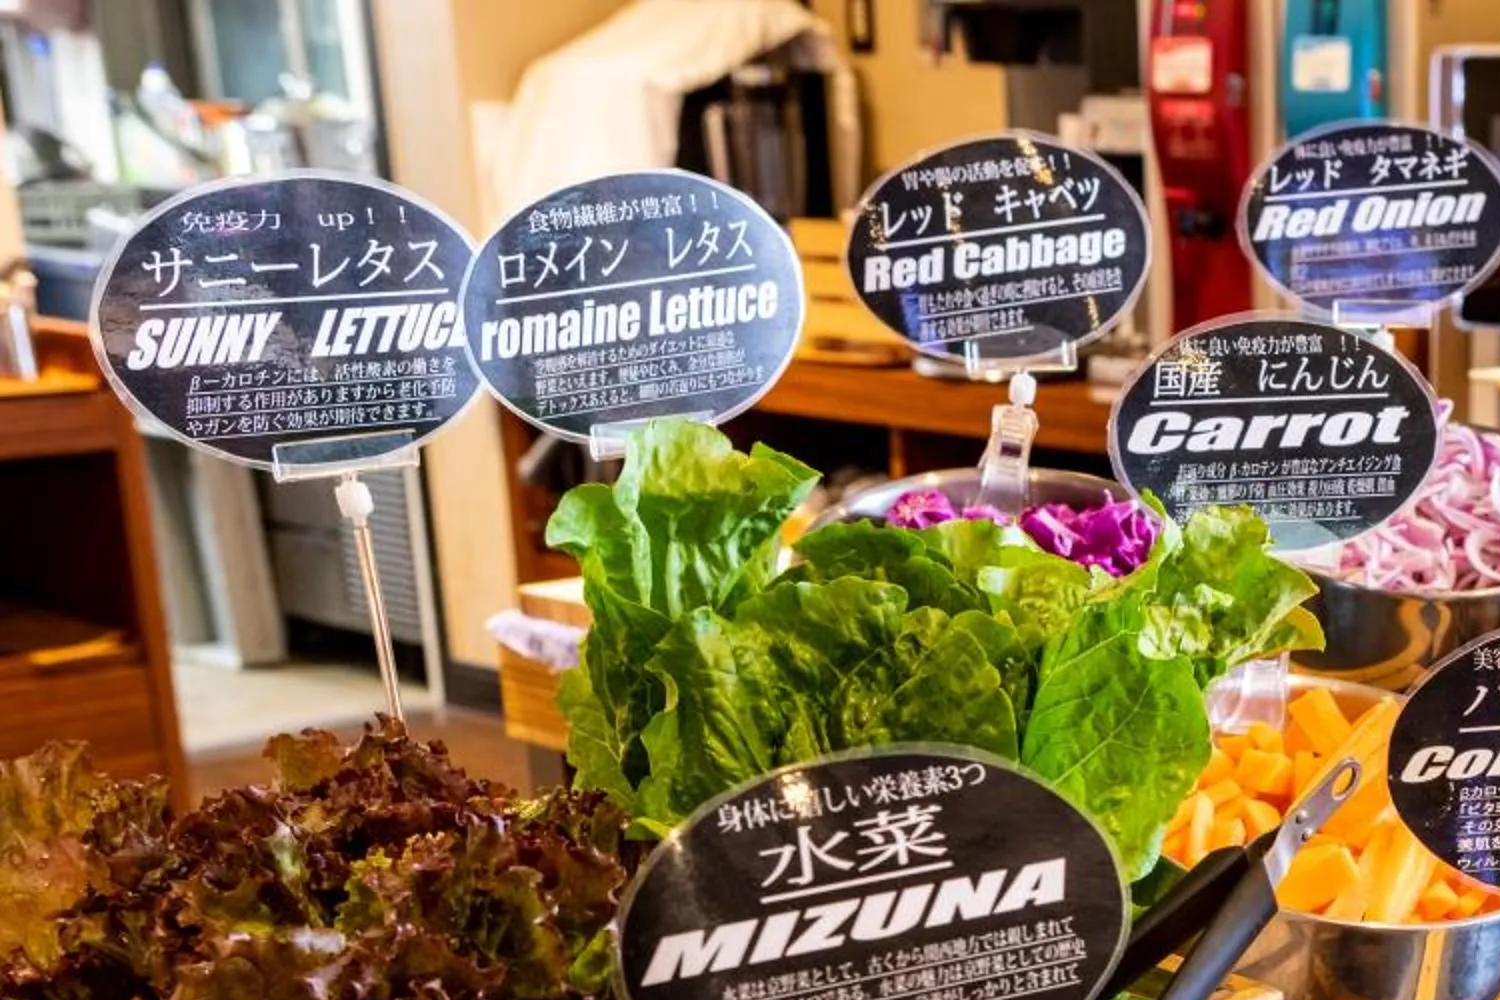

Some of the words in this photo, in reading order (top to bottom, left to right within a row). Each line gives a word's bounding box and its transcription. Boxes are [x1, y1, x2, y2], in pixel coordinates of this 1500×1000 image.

[1270, 159, 1342, 193] レッド
[1370, 148, 1470, 185] タマネギ
[182, 208, 281, 233] 免疫力
[881, 191, 963, 238] レッド
[993, 178, 1100, 223] キャベツ
[1253, 199, 1350, 241] Red
[1352, 191, 1487, 233] Onion
[142, 239, 446, 297] サニーレタス
[498, 236, 629, 289] ロメイン
[665, 220, 754, 269] レタス
[863, 248, 944, 292] Red
[954, 227, 1126, 279] Cabbage
[127, 311, 282, 371] SUNNY
[481, 300, 640, 361] romaine
[649, 281, 779, 336] Lettuce
[1153, 359, 1222, 399] 国産
[1257, 354, 1390, 393] にんじん
[1127, 405, 1410, 455] Carrot
[759, 804, 948, 888] 水菜
[641, 857, 1066, 987] MIZUNA
